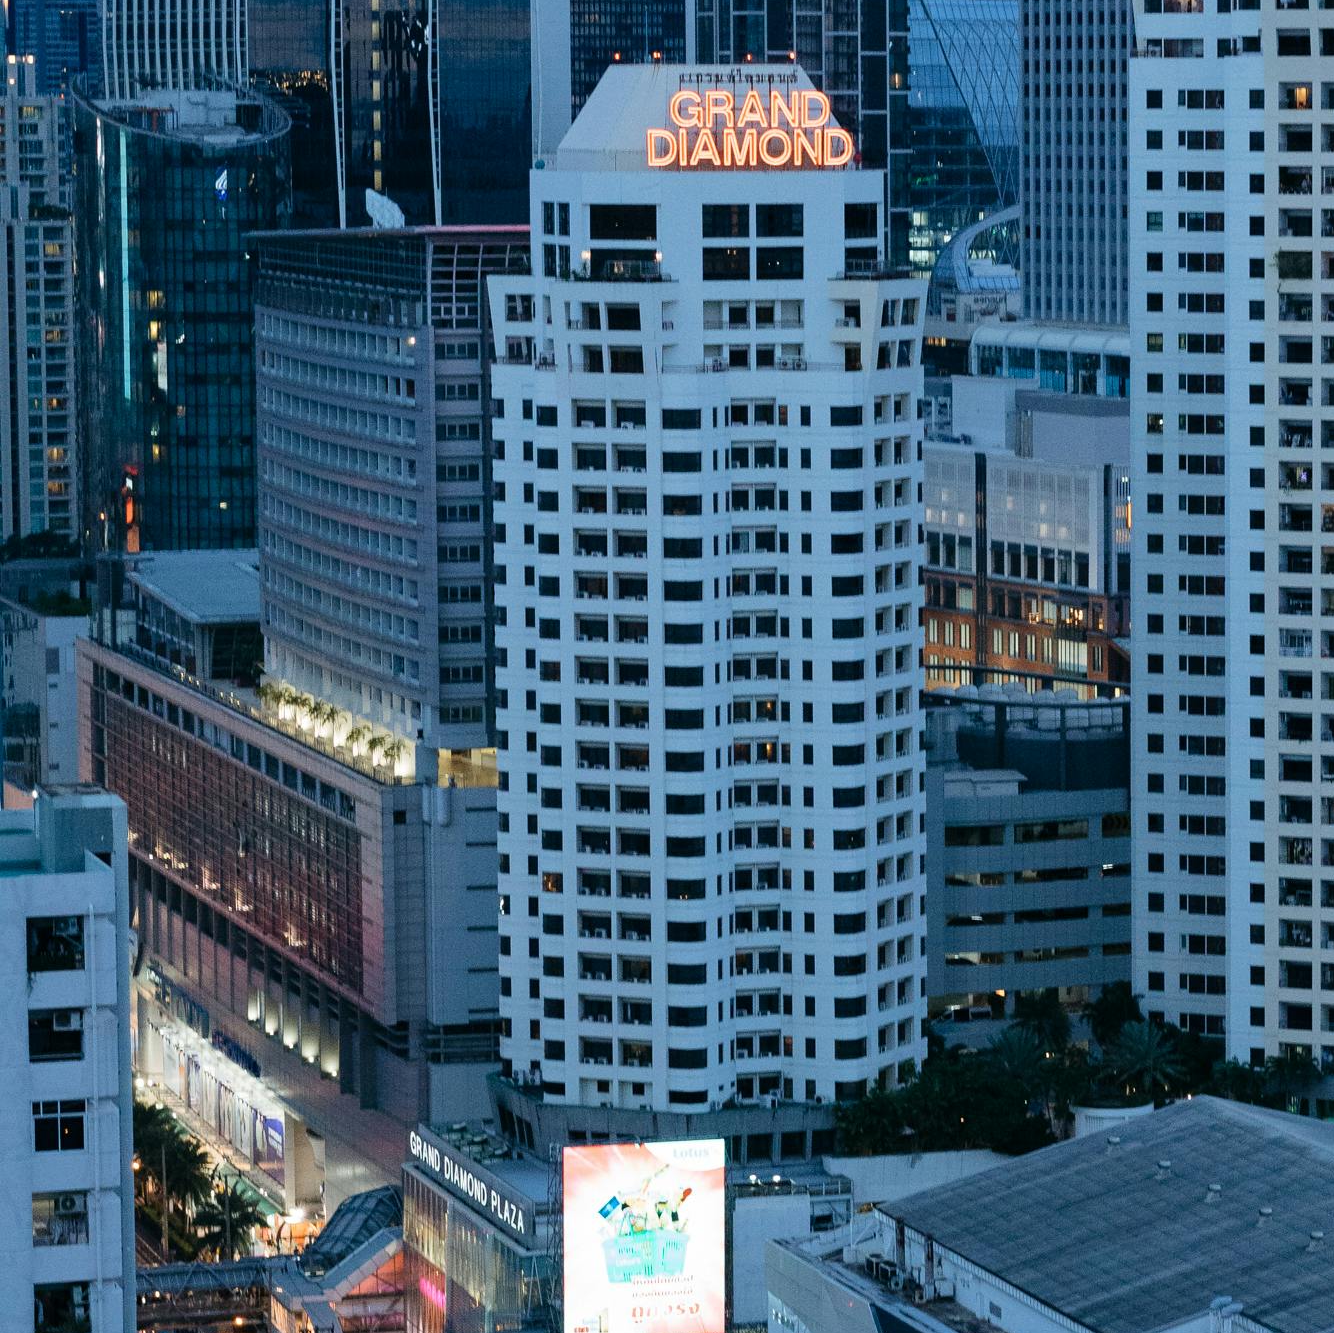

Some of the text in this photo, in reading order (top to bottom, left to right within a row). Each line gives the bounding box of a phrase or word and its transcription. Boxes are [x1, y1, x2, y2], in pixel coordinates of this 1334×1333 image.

[669, 90, 831, 128] GRAND
[646, 128, 853, 167] DIAMOND
[410, 1130, 524, 1234] GRAND DIAMOND PLAZA
